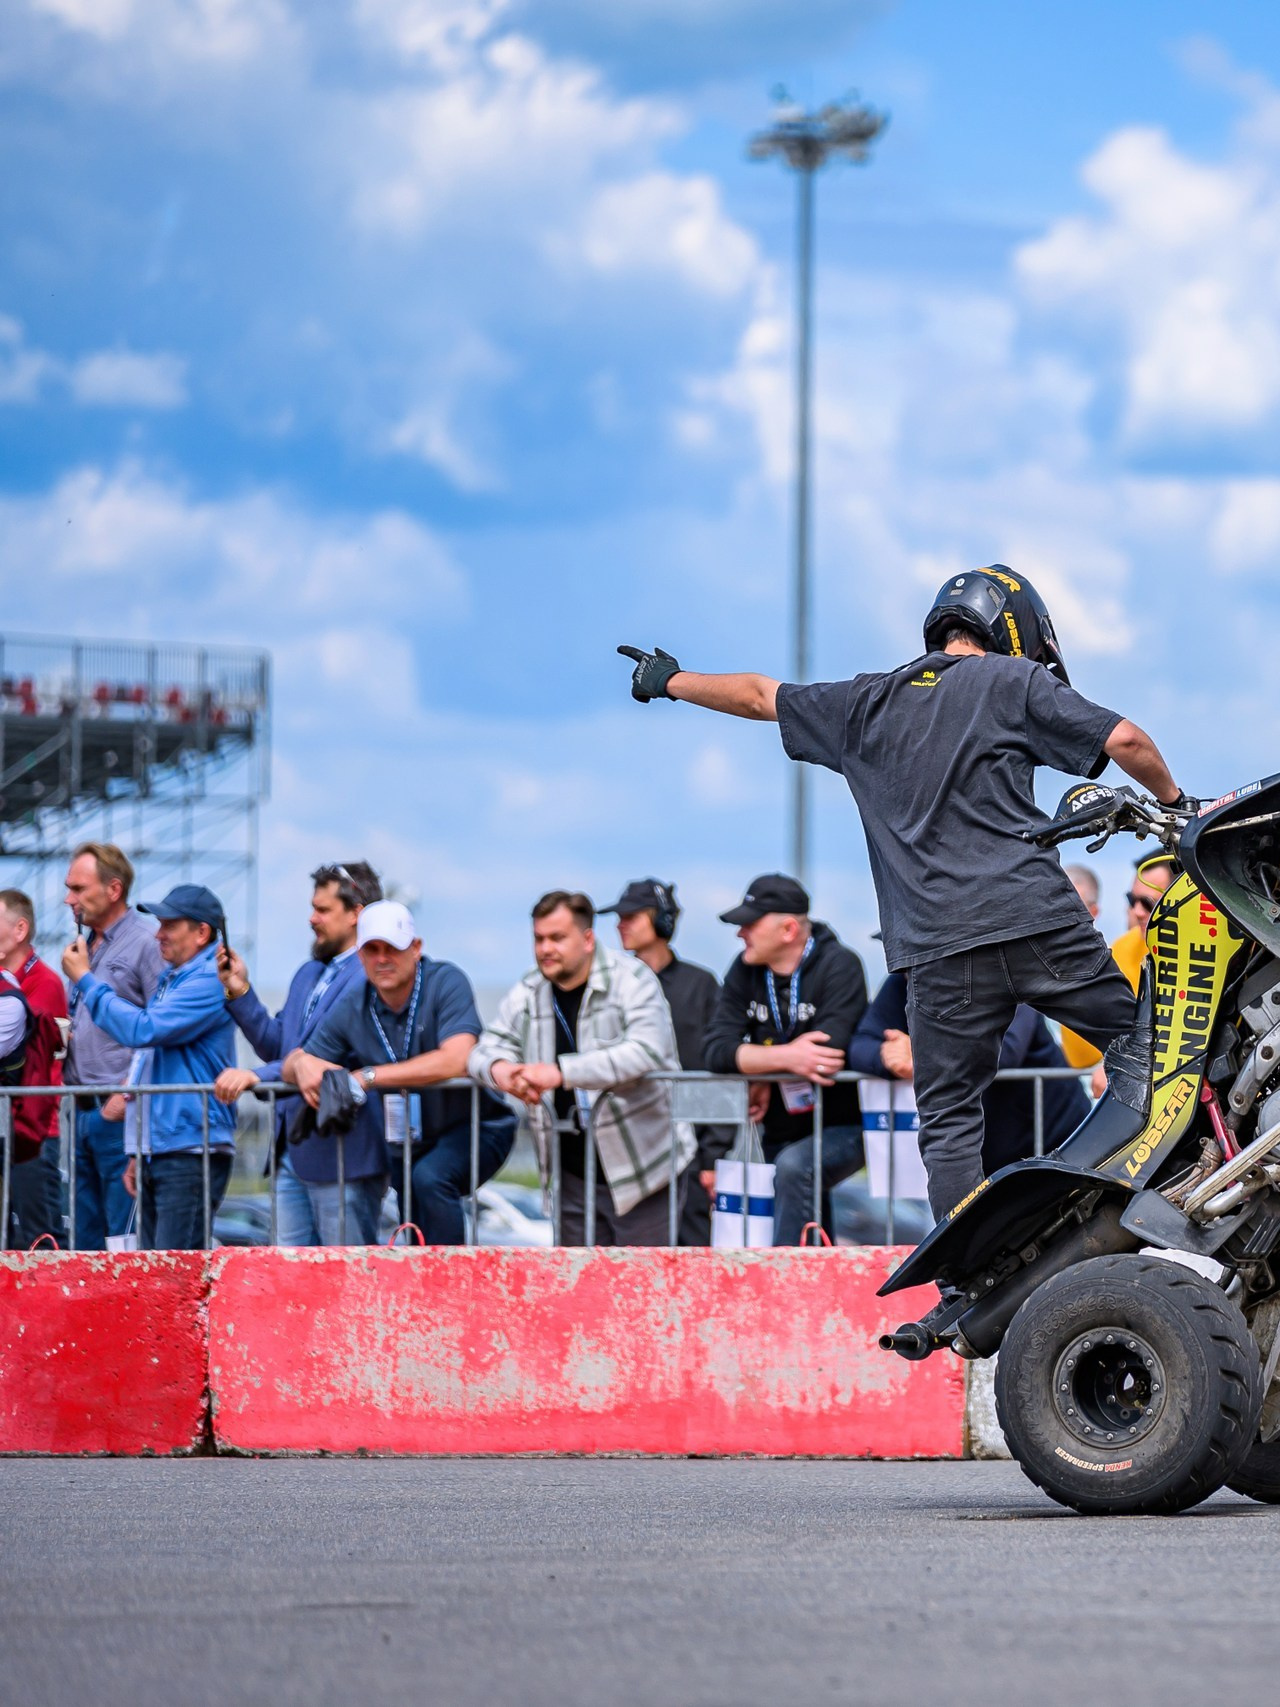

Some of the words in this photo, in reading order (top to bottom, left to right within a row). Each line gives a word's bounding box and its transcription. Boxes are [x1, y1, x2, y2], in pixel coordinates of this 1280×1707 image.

[1125, 1080, 1195, 1178] LUBSAR
[1054, 1447, 1105, 1472] SPEEDRACER
[1105, 1459, 1133, 1472] KENDA
